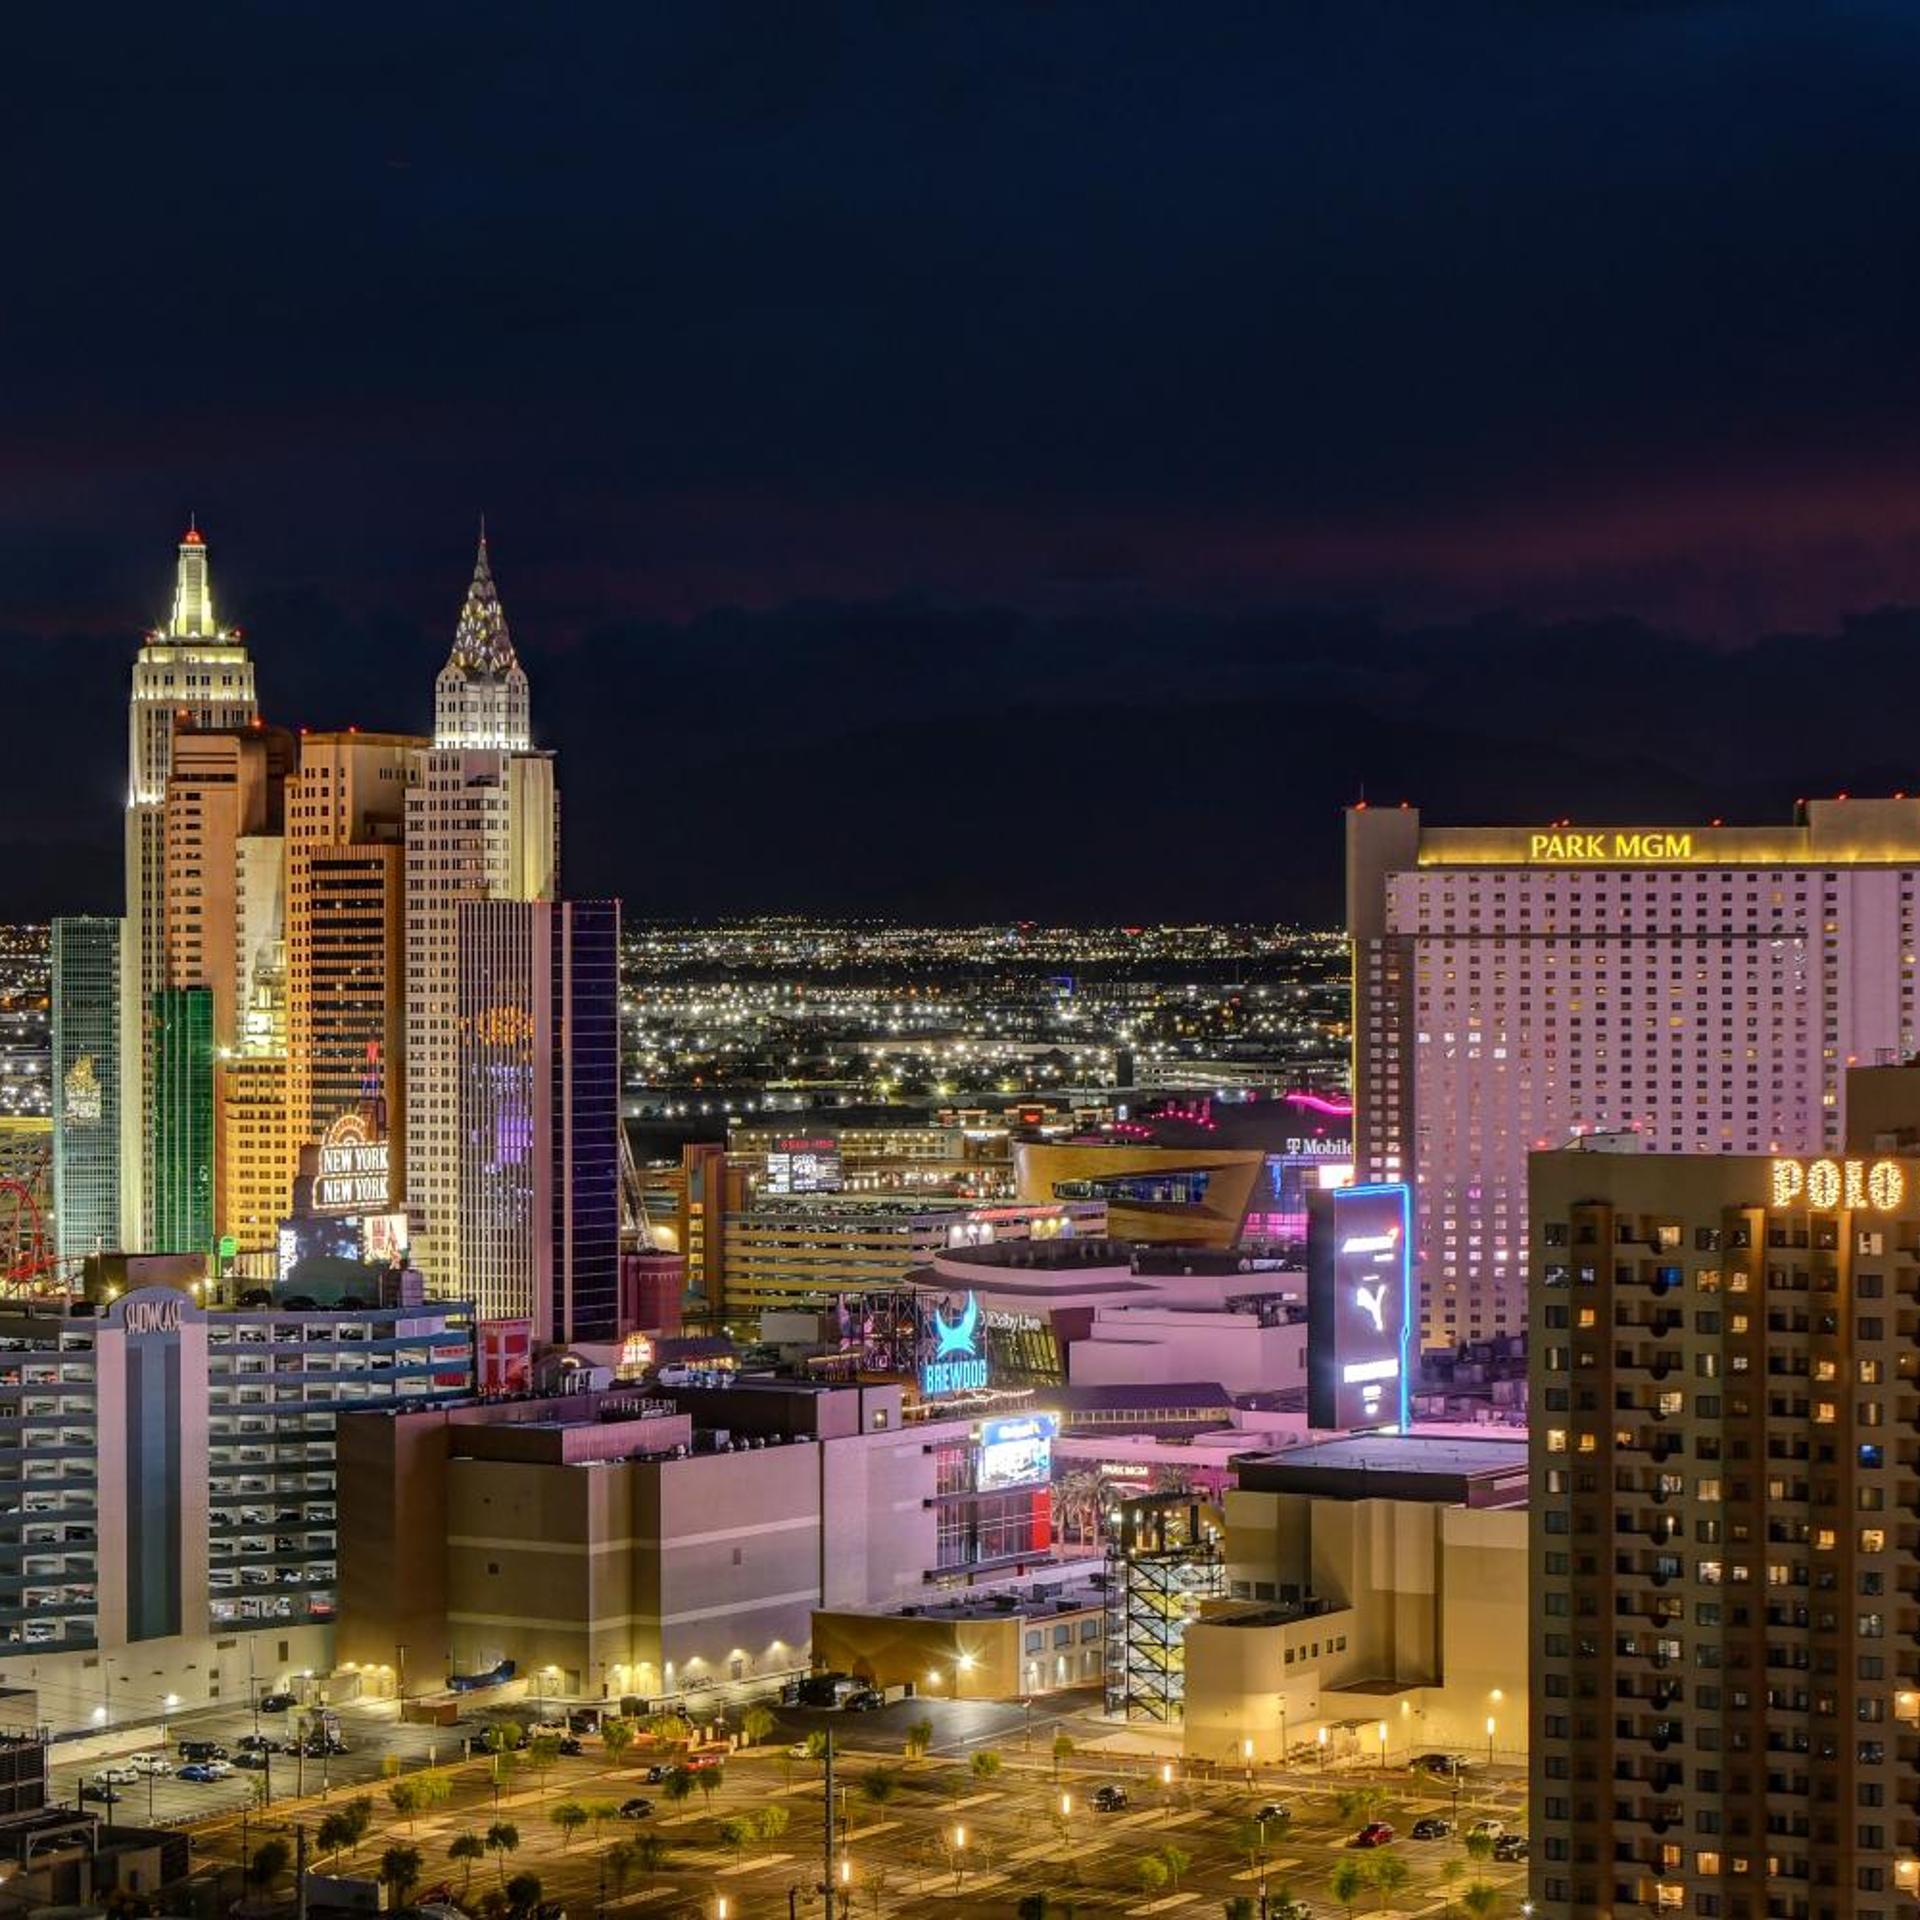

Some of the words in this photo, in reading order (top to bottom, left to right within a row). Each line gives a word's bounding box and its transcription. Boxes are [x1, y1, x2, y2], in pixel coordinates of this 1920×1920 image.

[1531, 835, 1605, 857] PARK
[1616, 834, 1691, 857] MGM
[324, 1149, 352, 1173] NEW
[355, 1147, 389, 1171] YORK
[324, 1178, 352, 1203] NEW
[355, 1176, 389, 1201] YORK
[1773, 1159, 1904, 1210] POLO
[125, 1300, 185, 1336] SHOWCASE
[926, 1359, 987, 1393] BREWDOG
